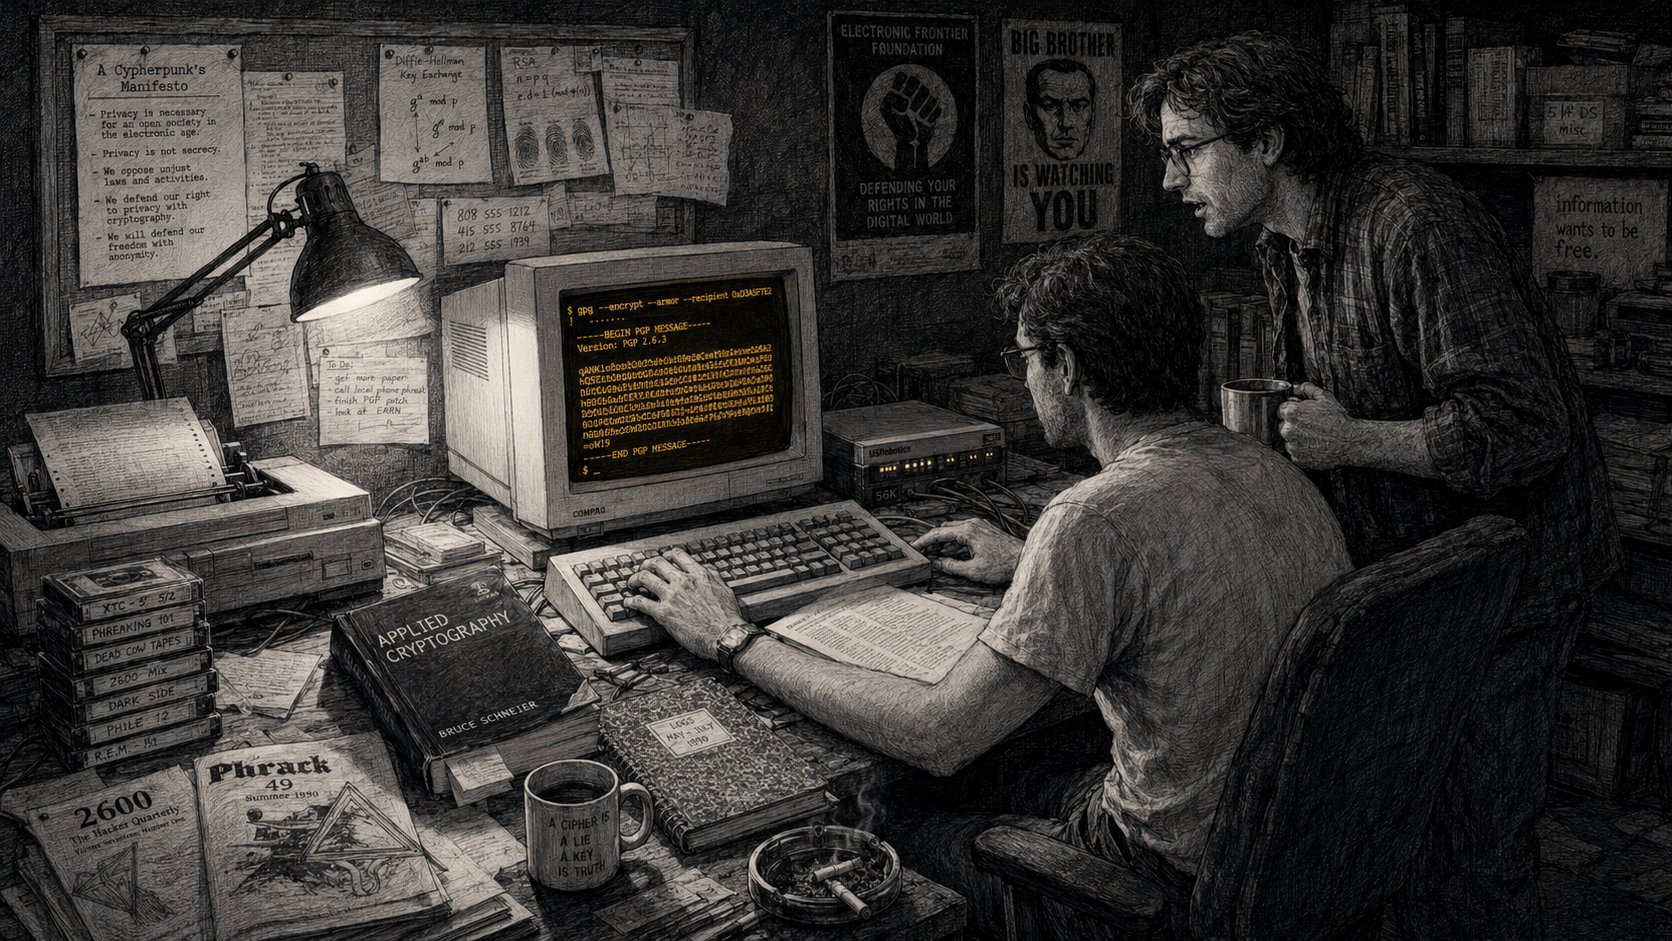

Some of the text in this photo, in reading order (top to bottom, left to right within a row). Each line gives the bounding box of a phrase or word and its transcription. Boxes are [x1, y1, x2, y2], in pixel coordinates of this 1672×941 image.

[841, 24, 968, 40] ELECTRONIC FRONTIER
[872, 42, 943, 56] FOUNDATION
[1011, 30, 1115, 58] BIG BROTHER
[513, 57, 535, 67] RSA
[97, 64, 206, 79] A Cypherpunk's
[401, 69, 462, 84] Key Exchange
[121, 80, 188, 92] Manifesto
[430, 94, 458, 108] mod p
[100, 110, 138, 120] Privacy
[160, 109, 206, 118] necessary
[1580, 107, 1597, 119] DS
[101, 117, 217, 131] for an open society in
[1559, 124, 1588, 135] misc
[101, 129, 200, 140] the electronic age.
[103, 146, 221, 158] Privacy is not secrecy.
[103, 167, 116, 176] We
[160, 164, 191, 174] unjust
[435, 156, 452, 167] mod
[458, 160, 464, 170] p
[104, 173, 208, 186] laws and activities.
[1013, 162, 1114, 187] IS WATCHING
[860, 178, 956, 196] DEFENDING YOUR
[105, 196, 118, 205] We
[123, 193, 158, 204] defend
[185, 190, 211, 202] right
[868, 195, 953, 213] RIGHTS IN THE
[1556, 194, 1643, 214] information
[106, 201, 188, 216] to privacy with
[457, 208, 478, 223] 808
[509, 206, 531, 218] 1212
[1029, 189, 1098, 232] YOU
[106, 213, 175, 226] cryptography.
[866, 211, 953, 229] DIGITAL WORLD
[107, 226, 205, 241] We will defend our
[457, 226, 476, 238] 415
[510, 221, 536, 233] 8764
[1555, 220, 1639, 239] wants to be
[152, 238, 174, 248] with
[459, 242, 476, 254] 212
[510, 236, 530, 248] 1939
[1554, 239, 1599, 259] free.
[108, 250, 159, 262] anonymity.
[567, 305, 573, 316] $
[577, 305, 594, 317] gpg
[598, 299, 645, 312] --encrypt
[635, 325, 651, 336] PGP
[577, 334, 668, 354] Version: PGP 2.6.3
[326, 359, 337, 369] To
[334, 374, 349, 386] get
[381, 374, 408, 385] paper
[334, 384, 350, 394] call
[353, 384, 373, 394] local
[334, 394, 408, 406] finish PGP patch
[335, 406, 402, 417] look at EARN
[632, 445, 649, 456] PGP
[582, 464, 589, 476] $
[875, 488, 898, 501] 56K
[572, 506, 606, 518] COMPAQ
[102, 601, 126, 615] XTC
[92, 613, 174, 640] PHREAKING 101
[377, 612, 450, 649] APPLIED
[385, 609, 513, 664] CRYPTOGRAPHY
[95, 635, 181, 664] DEAD COW TAPES
[110, 672, 139, 688] 2600
[108, 686, 175, 712] DARK SIDE
[106, 711, 169, 737] PHILE 12
[438, 700, 540, 739] BRUCE SCHNEIER
[666, 731, 685, 742] MAY
[94, 744, 131, 763] R.E.M.
[206, 755, 333, 785] Phrack
[265, 778, 294, 791] 49
[245, 793, 290, 802] Summer
[74, 790, 153, 830] 2600
[70, 806, 180, 844] The Hacker Quarterly
[548, 810, 610, 831] A CIPHER IS
[560, 834, 592, 847] A LIE
[560, 848, 594, 862] A KEY
[558, 858, 606, 878] IS TRUTH
